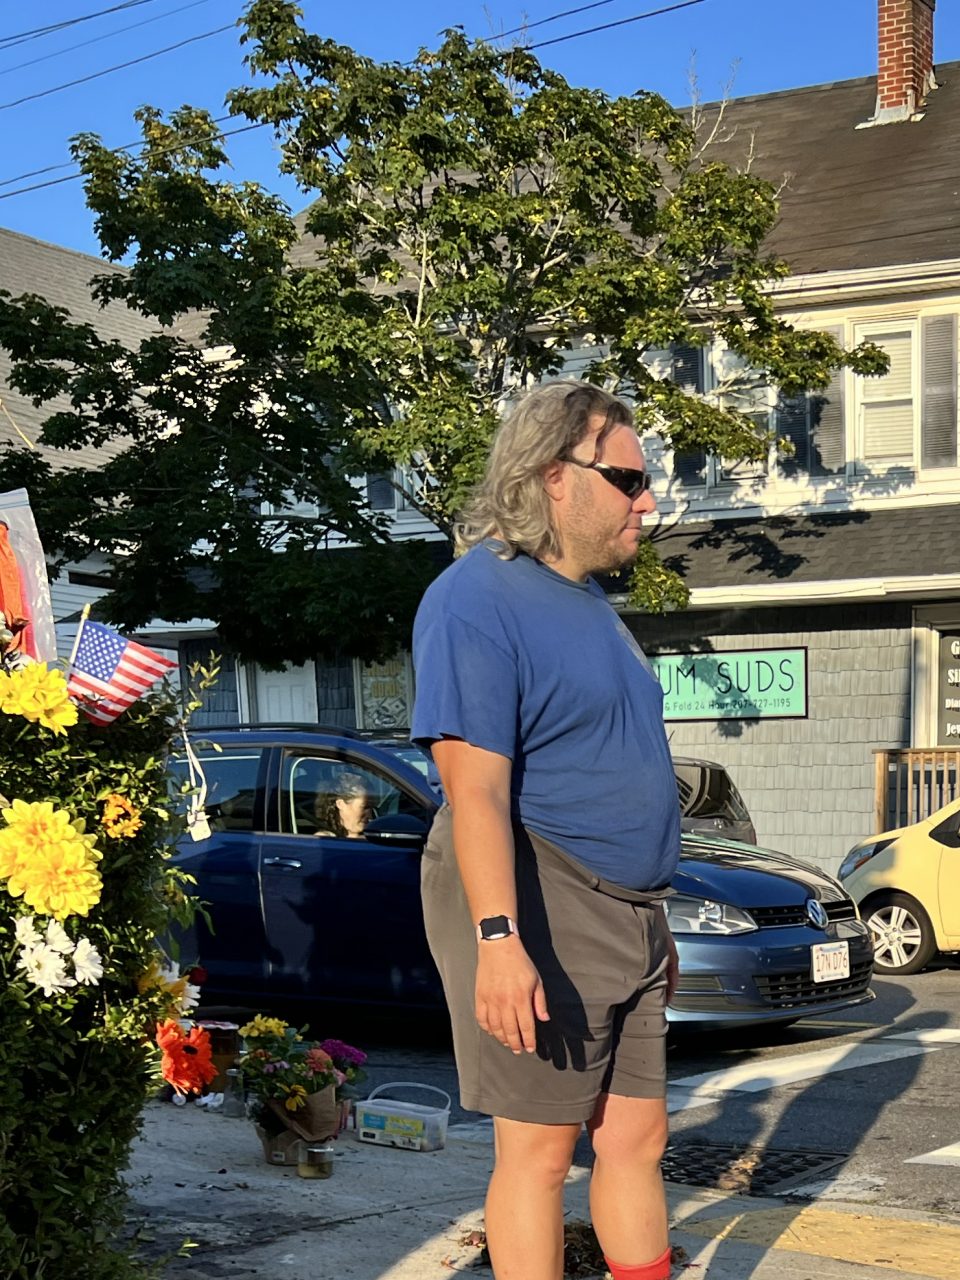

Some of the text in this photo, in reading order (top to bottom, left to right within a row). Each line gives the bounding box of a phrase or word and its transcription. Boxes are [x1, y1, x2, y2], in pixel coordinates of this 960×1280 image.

[717, 658, 794, 694] SUDS
[673, 702, 692, 711] Fold
[708, 700, 729, 710] Hour
